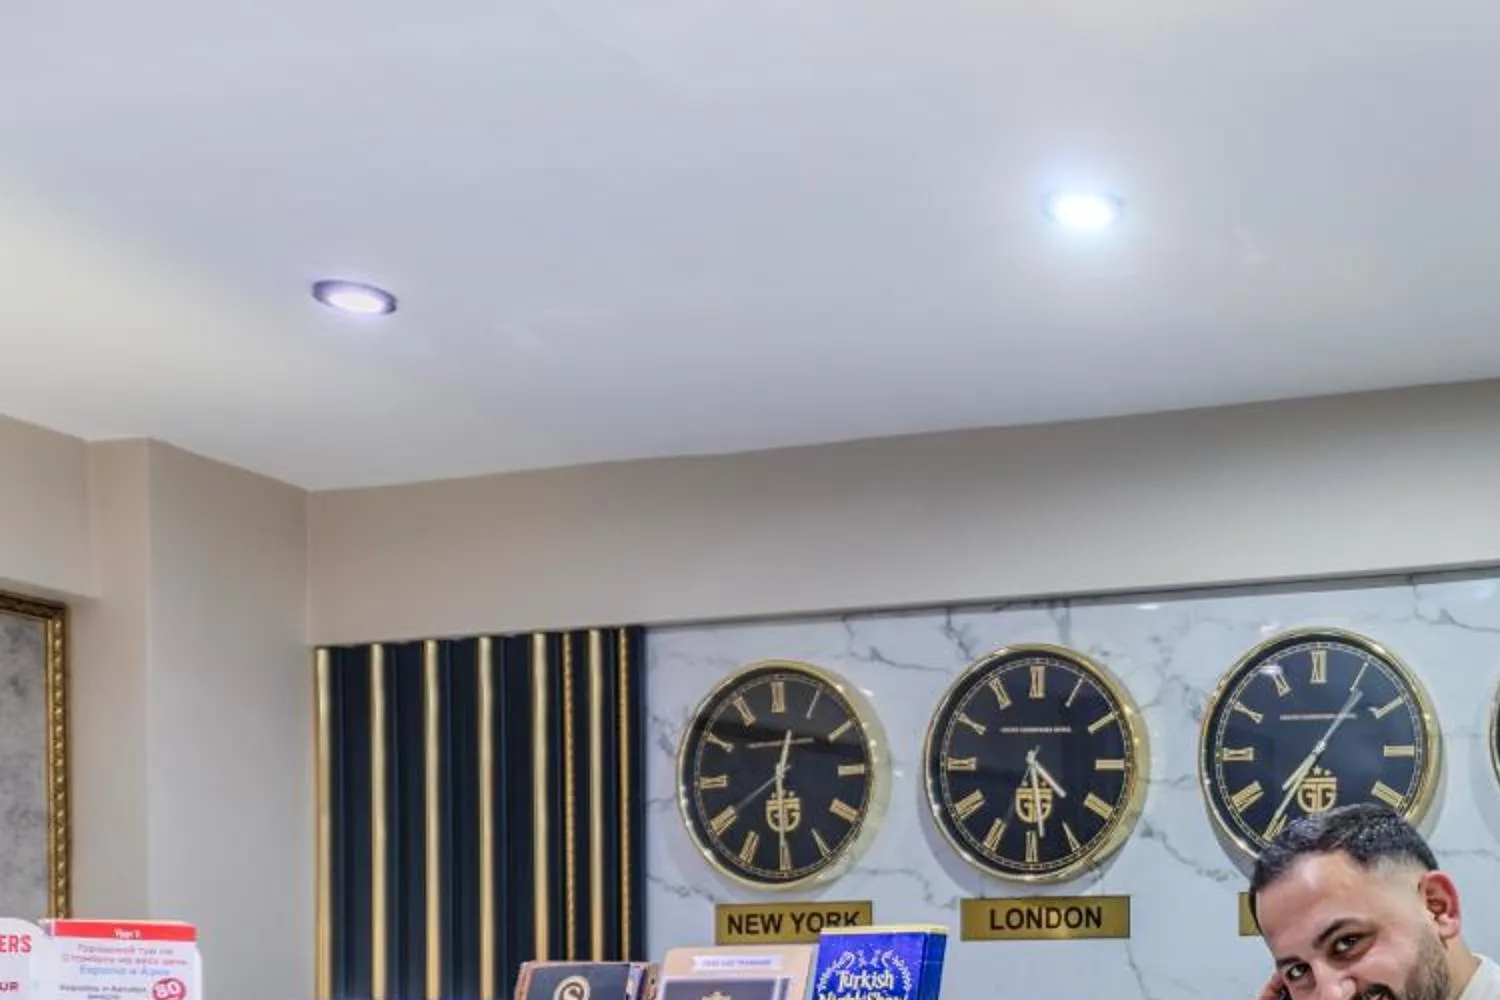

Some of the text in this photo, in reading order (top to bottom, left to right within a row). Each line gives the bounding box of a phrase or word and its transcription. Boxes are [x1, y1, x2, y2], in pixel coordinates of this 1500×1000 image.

[1310, 650, 1327, 683] XII
[989, 677, 1012, 709] XI
[1030, 665, 1046, 698] XII
[1065, 677, 1084, 707] I
[771, 681, 787, 713] XII
[806, 686, 823, 719] I
[1374, 697, 1404, 719] II
[734, 695, 757, 727] XI
[955, 711, 986, 735] X
[1087, 712, 1117, 734] II
[1231, 701, 1264, 724] X
[704, 731, 734, 752] X
[828, 720, 856, 742] II
[1223, 747, 1254, 761] IX
[1383, 745, 1415, 757] III
[838, 764, 865, 777] III
[947, 757, 977, 771] IX
[1095, 759, 1125, 770] III
[700, 774, 728, 790] IX
[811, 828, 832, 860] V
[1025, 831, 1038, 863] VI
[1062, 820, 1082, 852] V
[727, 911, 861, 935] NEW YORK
[990, 906, 1103, 931] LONDON
[837, 969, 894, 993] Turkish
